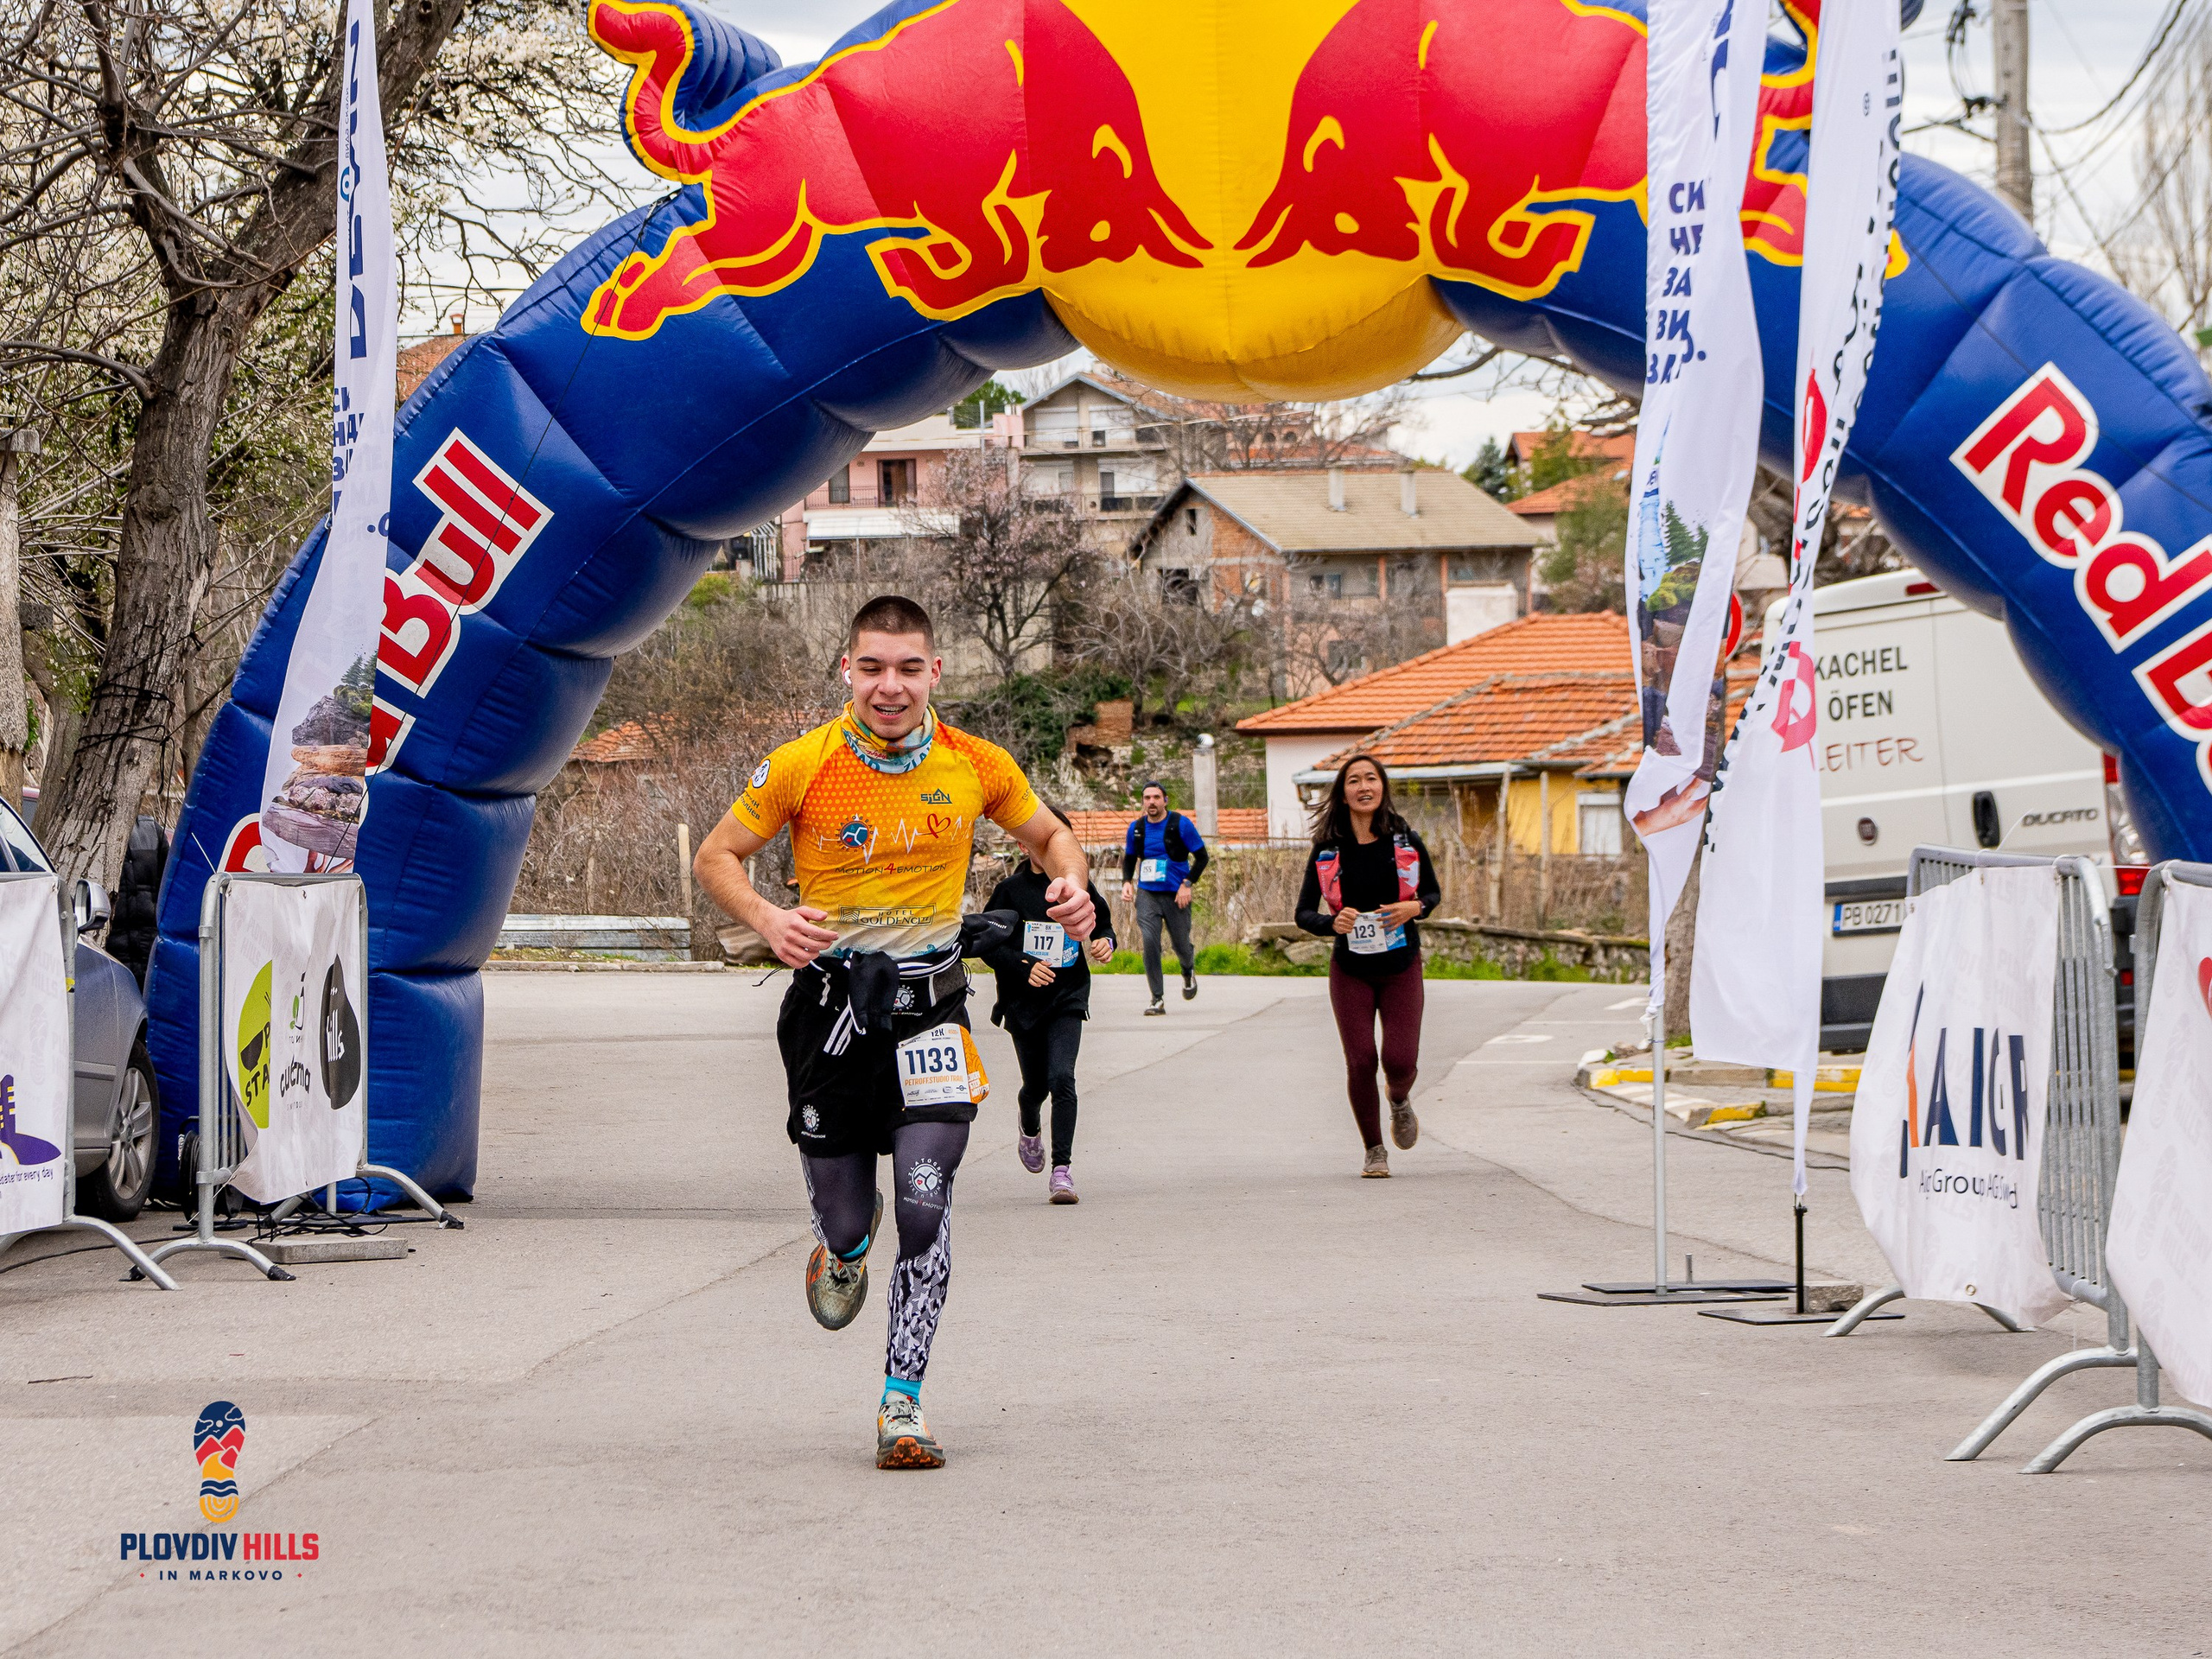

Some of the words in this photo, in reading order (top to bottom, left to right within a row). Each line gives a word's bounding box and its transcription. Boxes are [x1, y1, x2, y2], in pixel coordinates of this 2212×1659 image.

[1961, 370, 2212, 644] Red
[377, 434, 548, 691] Bull
[1815, 646, 1909, 681] KACHEL
[1827, 690, 1893, 721] ÖFEN
[1819, 737, 1924, 772] EITER
[2023, 809, 2099, 827] DUCATO
[1034, 935, 1054, 950] 117
[1353, 924, 1376, 939] 123
[931, 1028, 945, 1038] 12K
[904, 1046, 959, 1076] 1133
